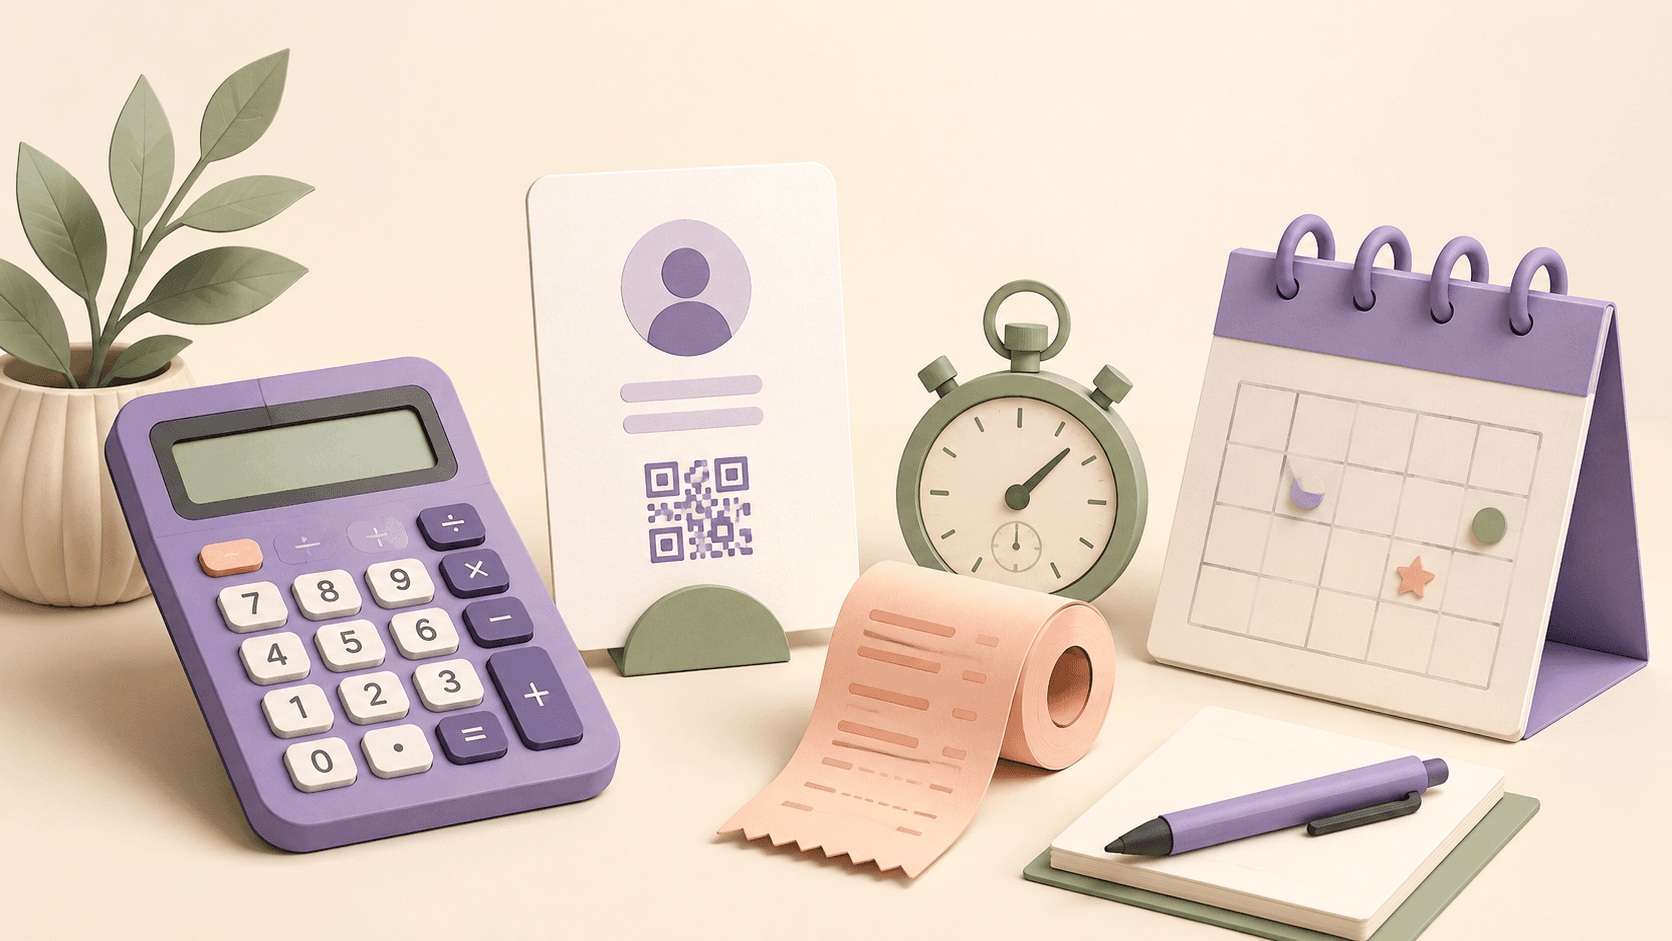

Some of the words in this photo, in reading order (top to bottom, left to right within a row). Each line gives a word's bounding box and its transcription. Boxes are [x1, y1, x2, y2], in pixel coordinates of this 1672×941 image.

[240, 591, 260, 615] 7
[316, 579, 340, 603] 8
[389, 568, 411, 591] 9
[267, 642, 288, 666] 4
[339, 629, 363, 654] 5
[415, 618, 438, 642] 6
[289, 695, 308, 719] 1
[363, 682, 388, 707] 2
[438, 669, 461, 694] 3
[310, 749, 334, 774] 0
